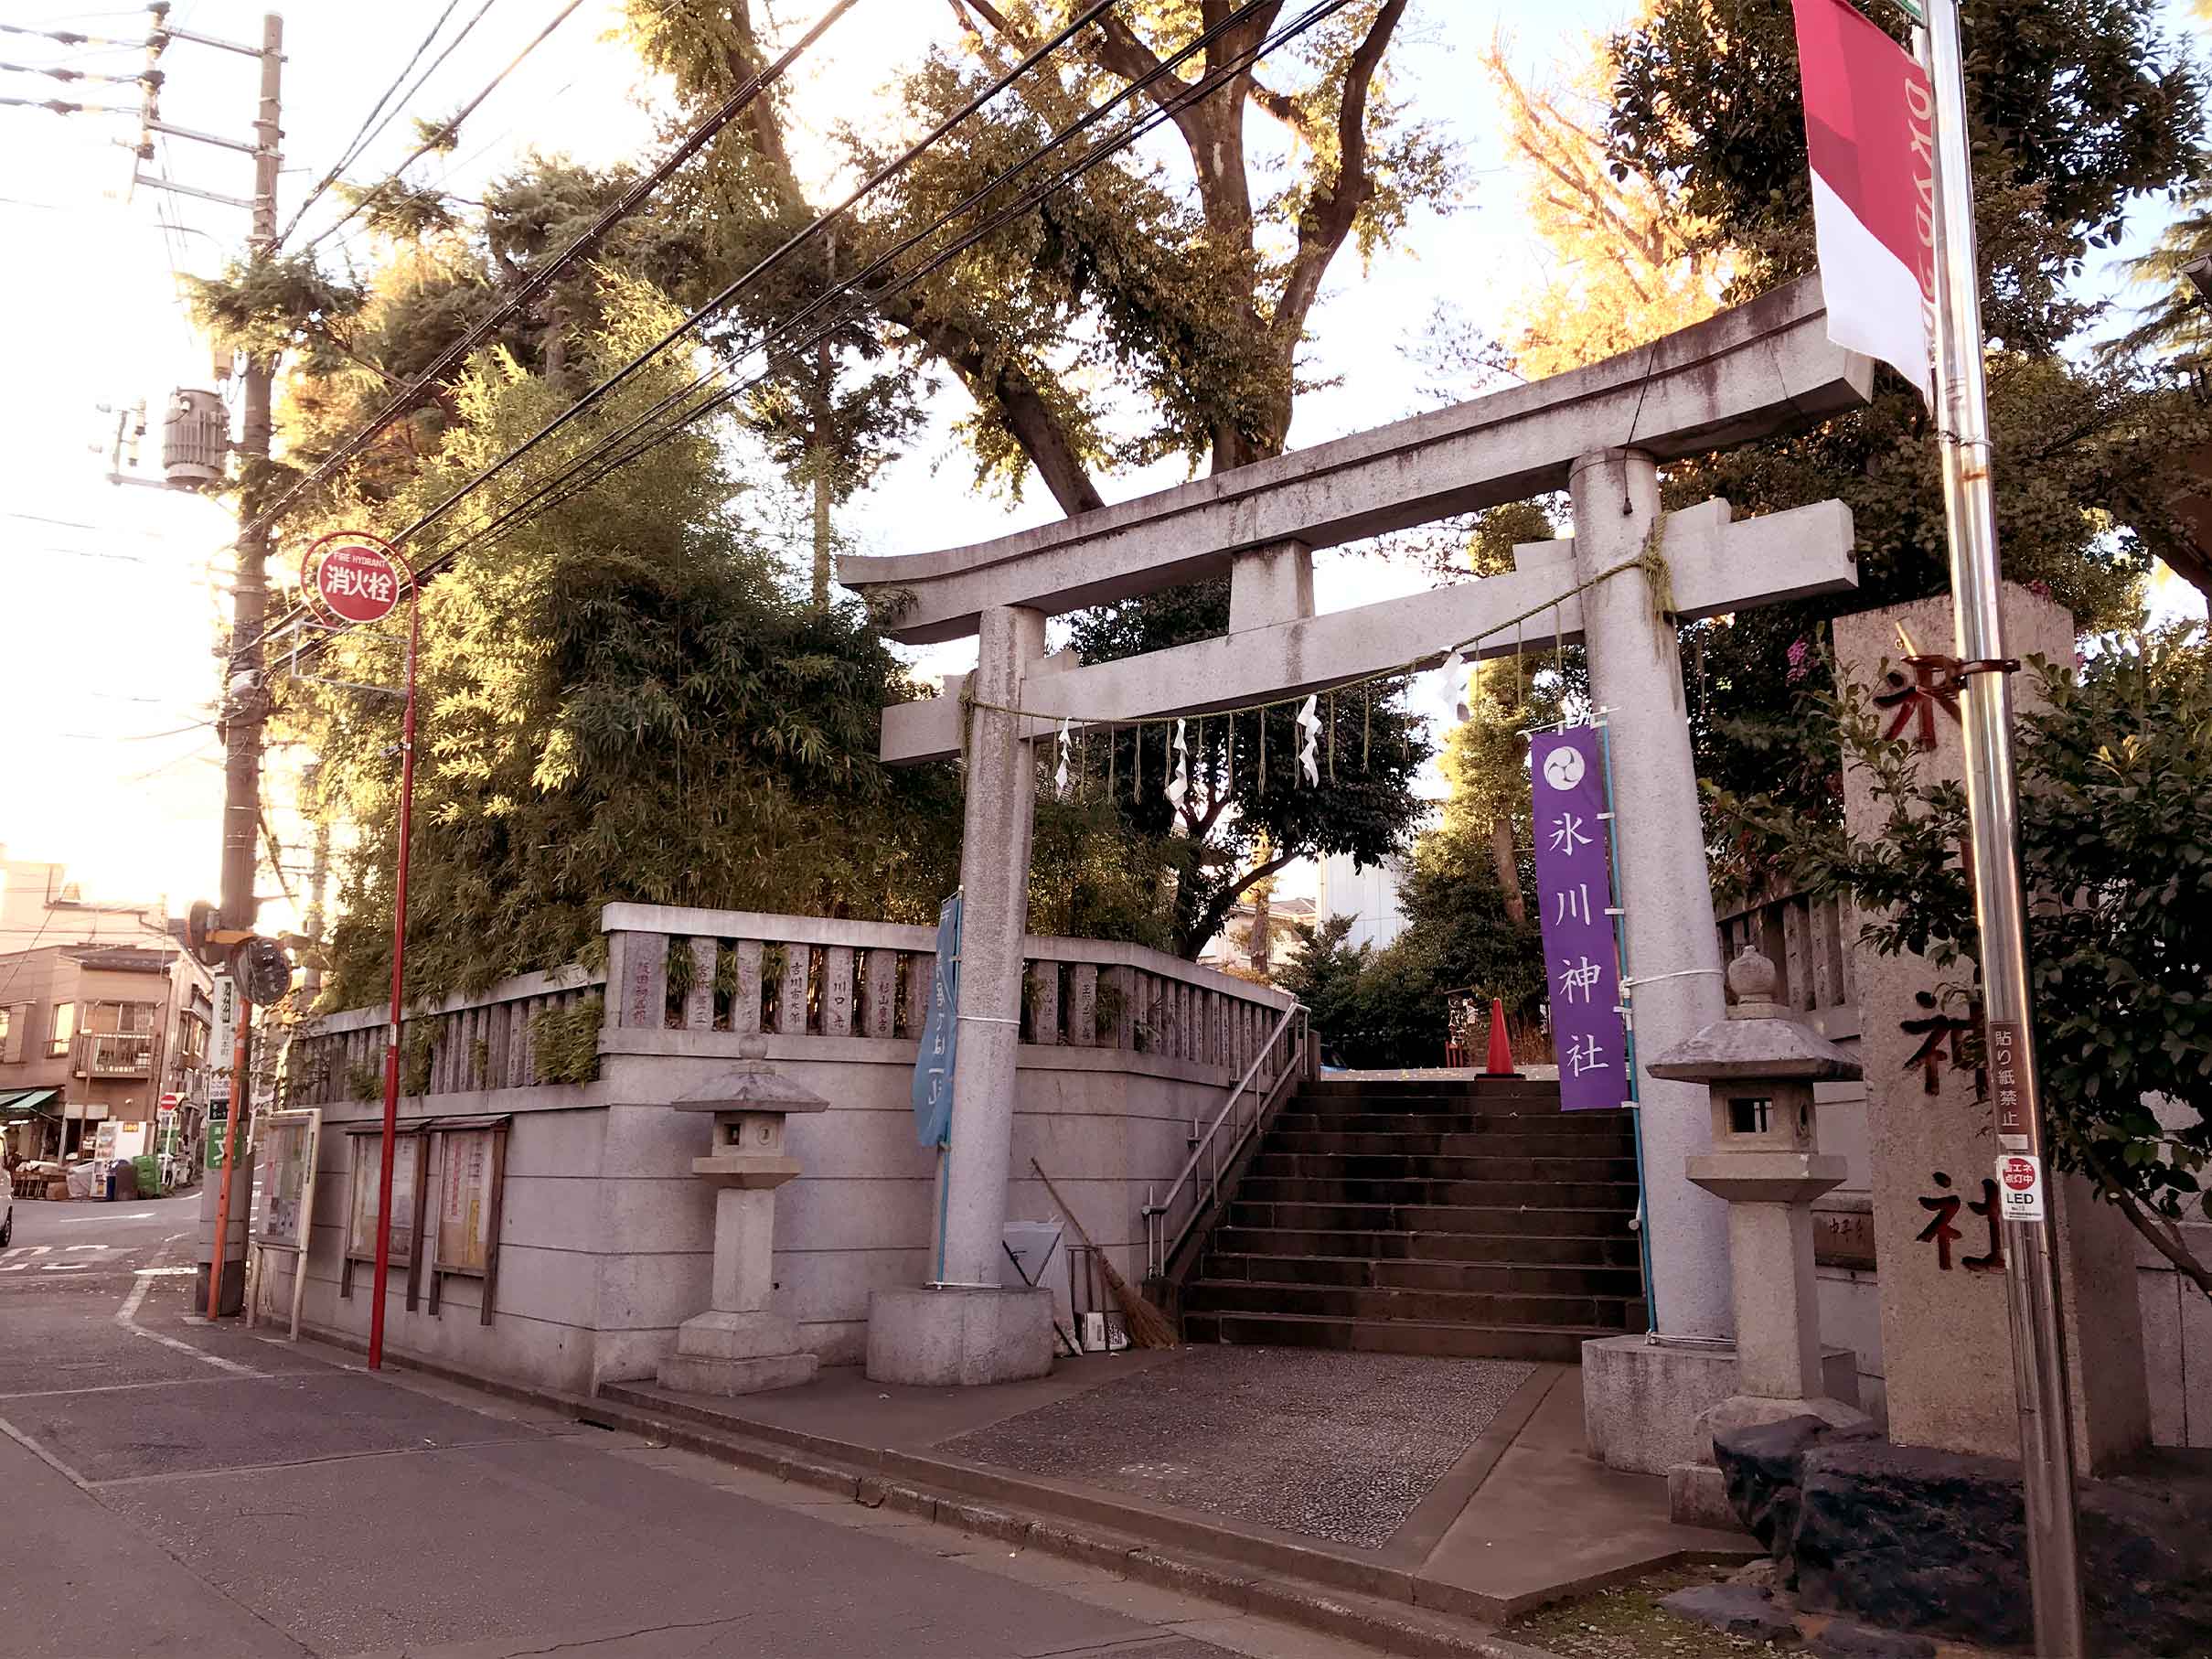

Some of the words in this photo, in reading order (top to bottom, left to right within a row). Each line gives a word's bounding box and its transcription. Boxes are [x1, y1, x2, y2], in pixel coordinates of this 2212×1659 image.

[333, 551, 351, 562] FIRE
[352, 555, 387, 568] HYDRANT
[326, 564, 393, 603] 消火栓
[1549, 812, 1609, 1077] 氷川神社
[1875, 660, 2005, 1272] 氷神社
[1995, 1031, 2019, 1127] 貼り紙禁止
[2005, 1173, 2033, 1183] 点灯中
[2006, 1193, 2034, 1204] LED
